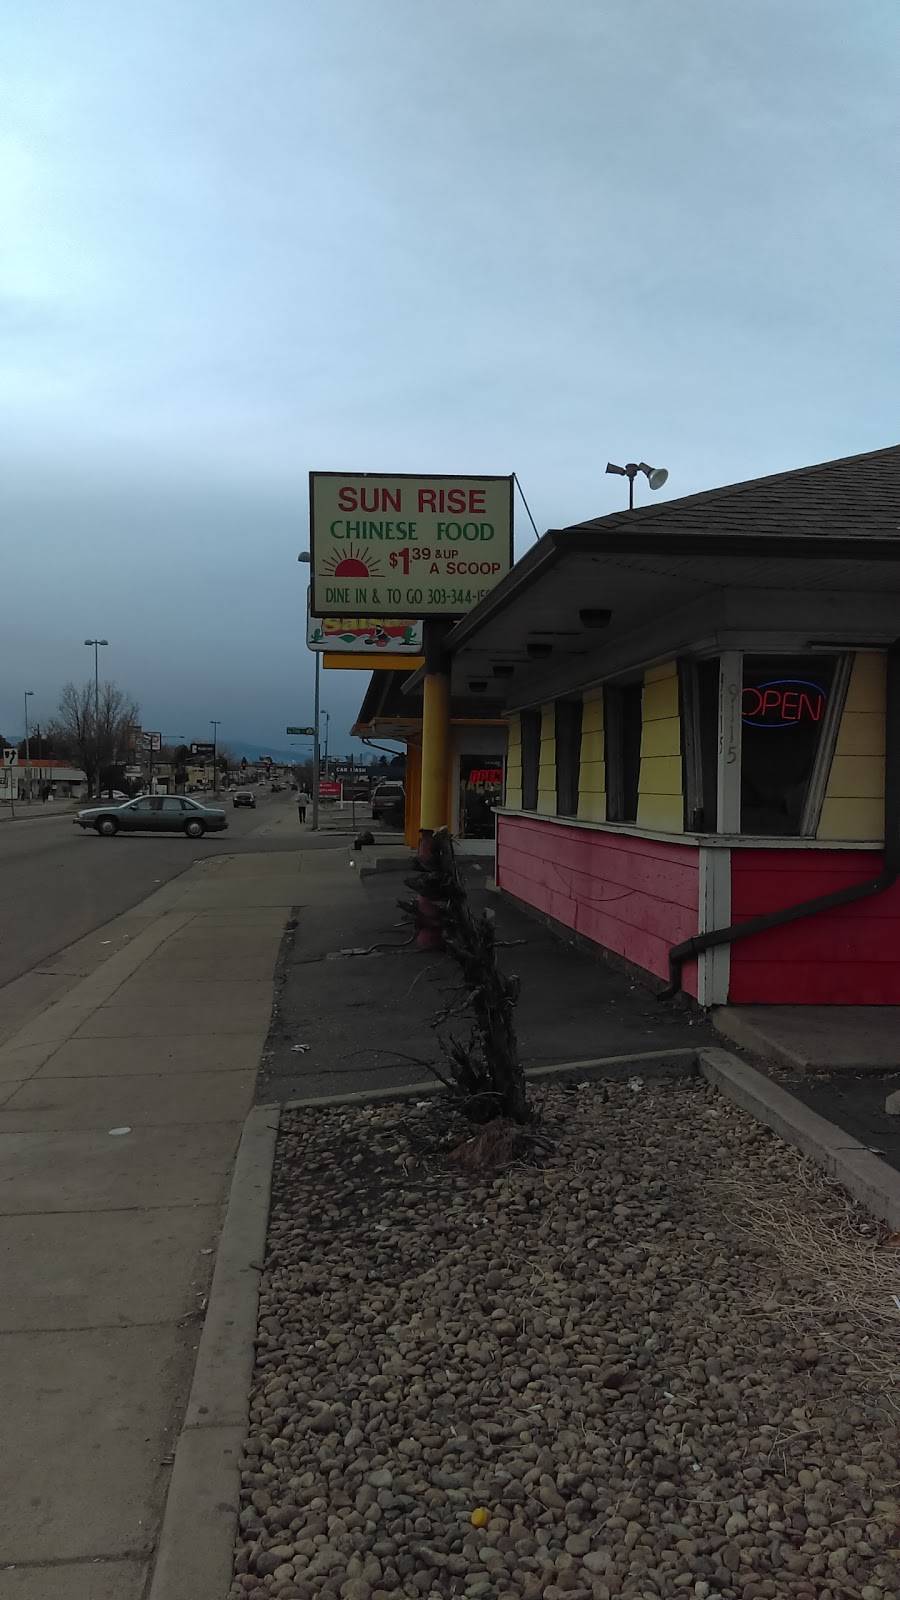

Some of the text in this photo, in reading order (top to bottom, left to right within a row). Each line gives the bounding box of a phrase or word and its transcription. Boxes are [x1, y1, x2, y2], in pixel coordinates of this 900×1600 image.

[338, 486, 487, 514] SUN RISE
[330, 520, 495, 541] CHINESE FOOD
[429, 561, 501, 575] A SCOOP
[325, 587, 350, 603] DINE
[355, 588, 367, 604] IN
[372, 588, 381, 604] &
[387, 588, 401, 604] TO
[406, 588, 423, 604] GO
[741, 687, 822, 721] OPEN
